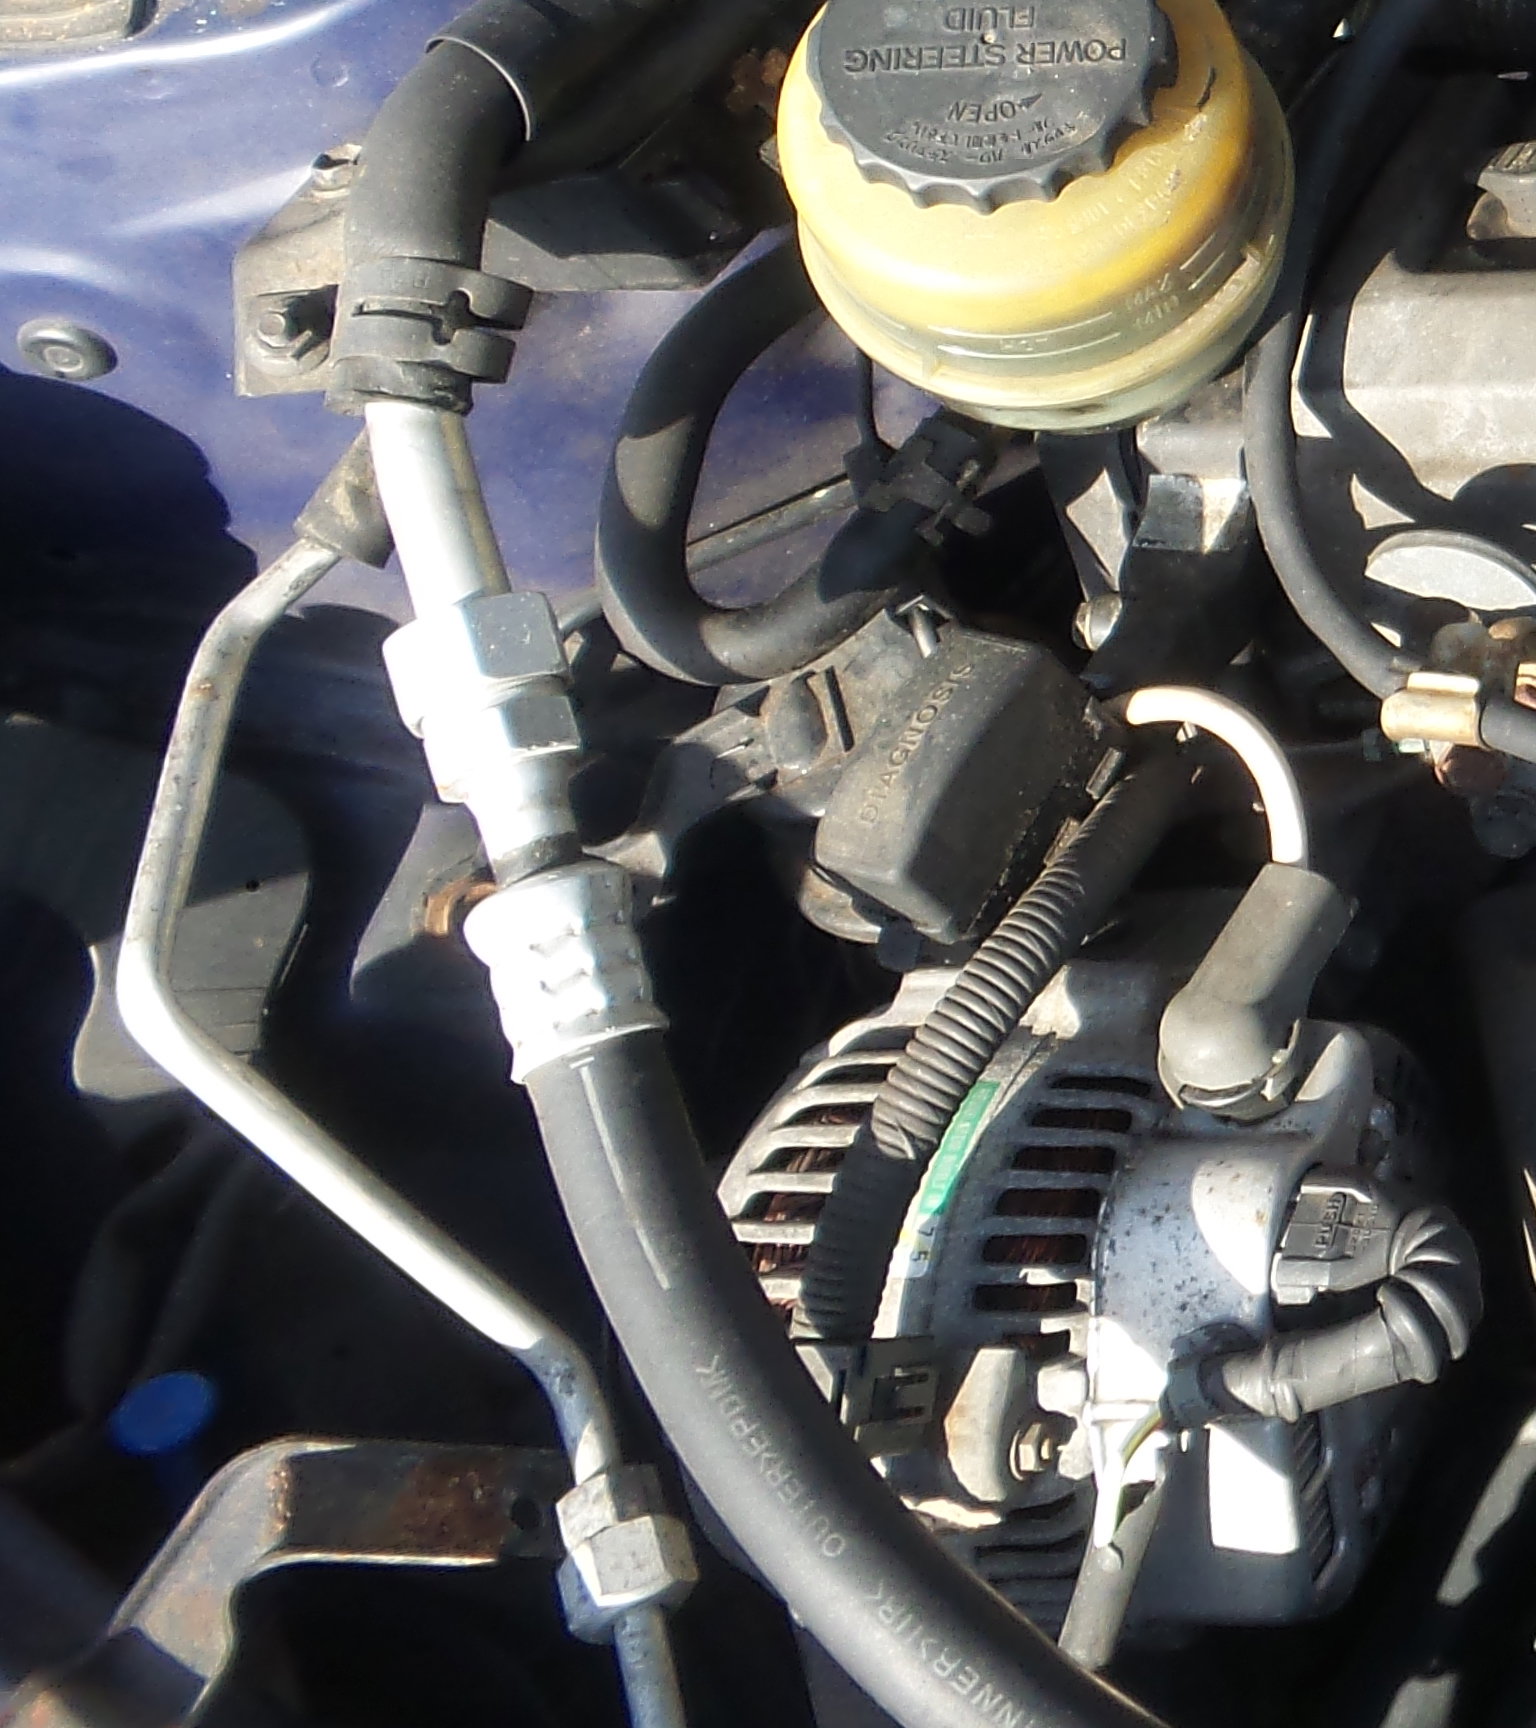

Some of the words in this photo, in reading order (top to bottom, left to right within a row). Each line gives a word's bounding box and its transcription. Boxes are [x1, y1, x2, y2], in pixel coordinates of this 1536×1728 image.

[943, 6, 1036, 32] FLUID
[843, 42, 1006, 73] STEERING
[1015, 38, 1127, 67] POWER
[946, 100, 1018, 125] OPEN
[860, 663, 975, 823] DIAGNOSIS
[1315, 1197, 1342, 1248] PUSH
